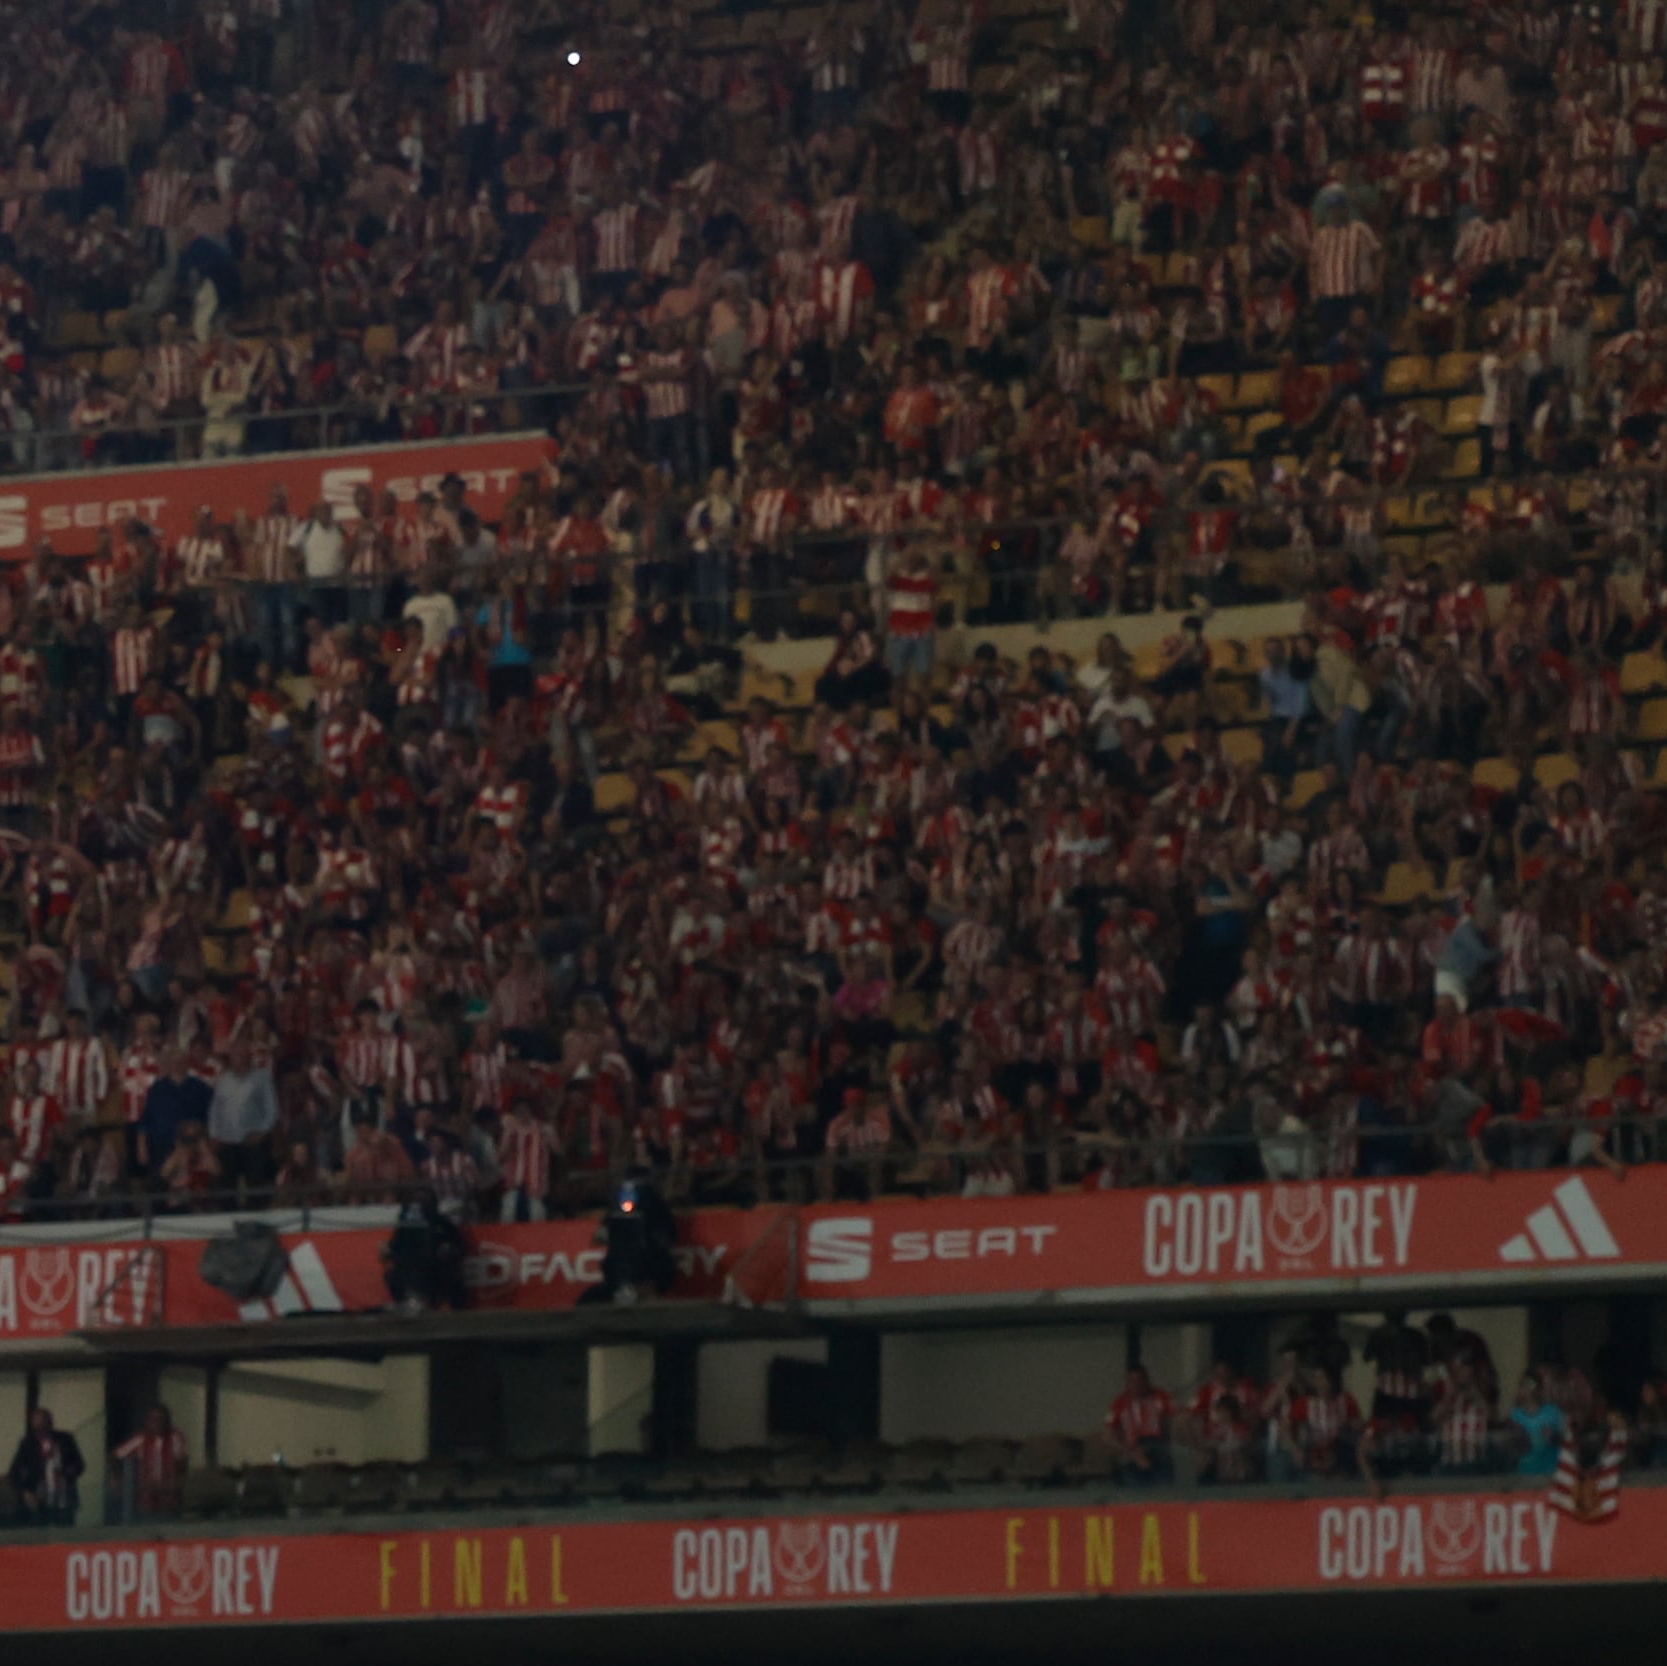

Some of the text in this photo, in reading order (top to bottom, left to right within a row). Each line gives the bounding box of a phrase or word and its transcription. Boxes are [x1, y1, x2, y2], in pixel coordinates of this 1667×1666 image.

[40, 497, 167, 528] SEAT
[890, 1225, 1058, 1263] SEAT
[1144, 1183, 1417, 1275] COPA REY
[77, 1249, 155, 1327] REY
[379, 1534, 570, 1610] FINAL
[672, 1523, 899, 1599] COPA REY
[1006, 1512, 1208, 1588] FINAL
[1318, 1502, 1560, 1580] COPA REY
[66, 1546, 279, 1620] COPA REY
